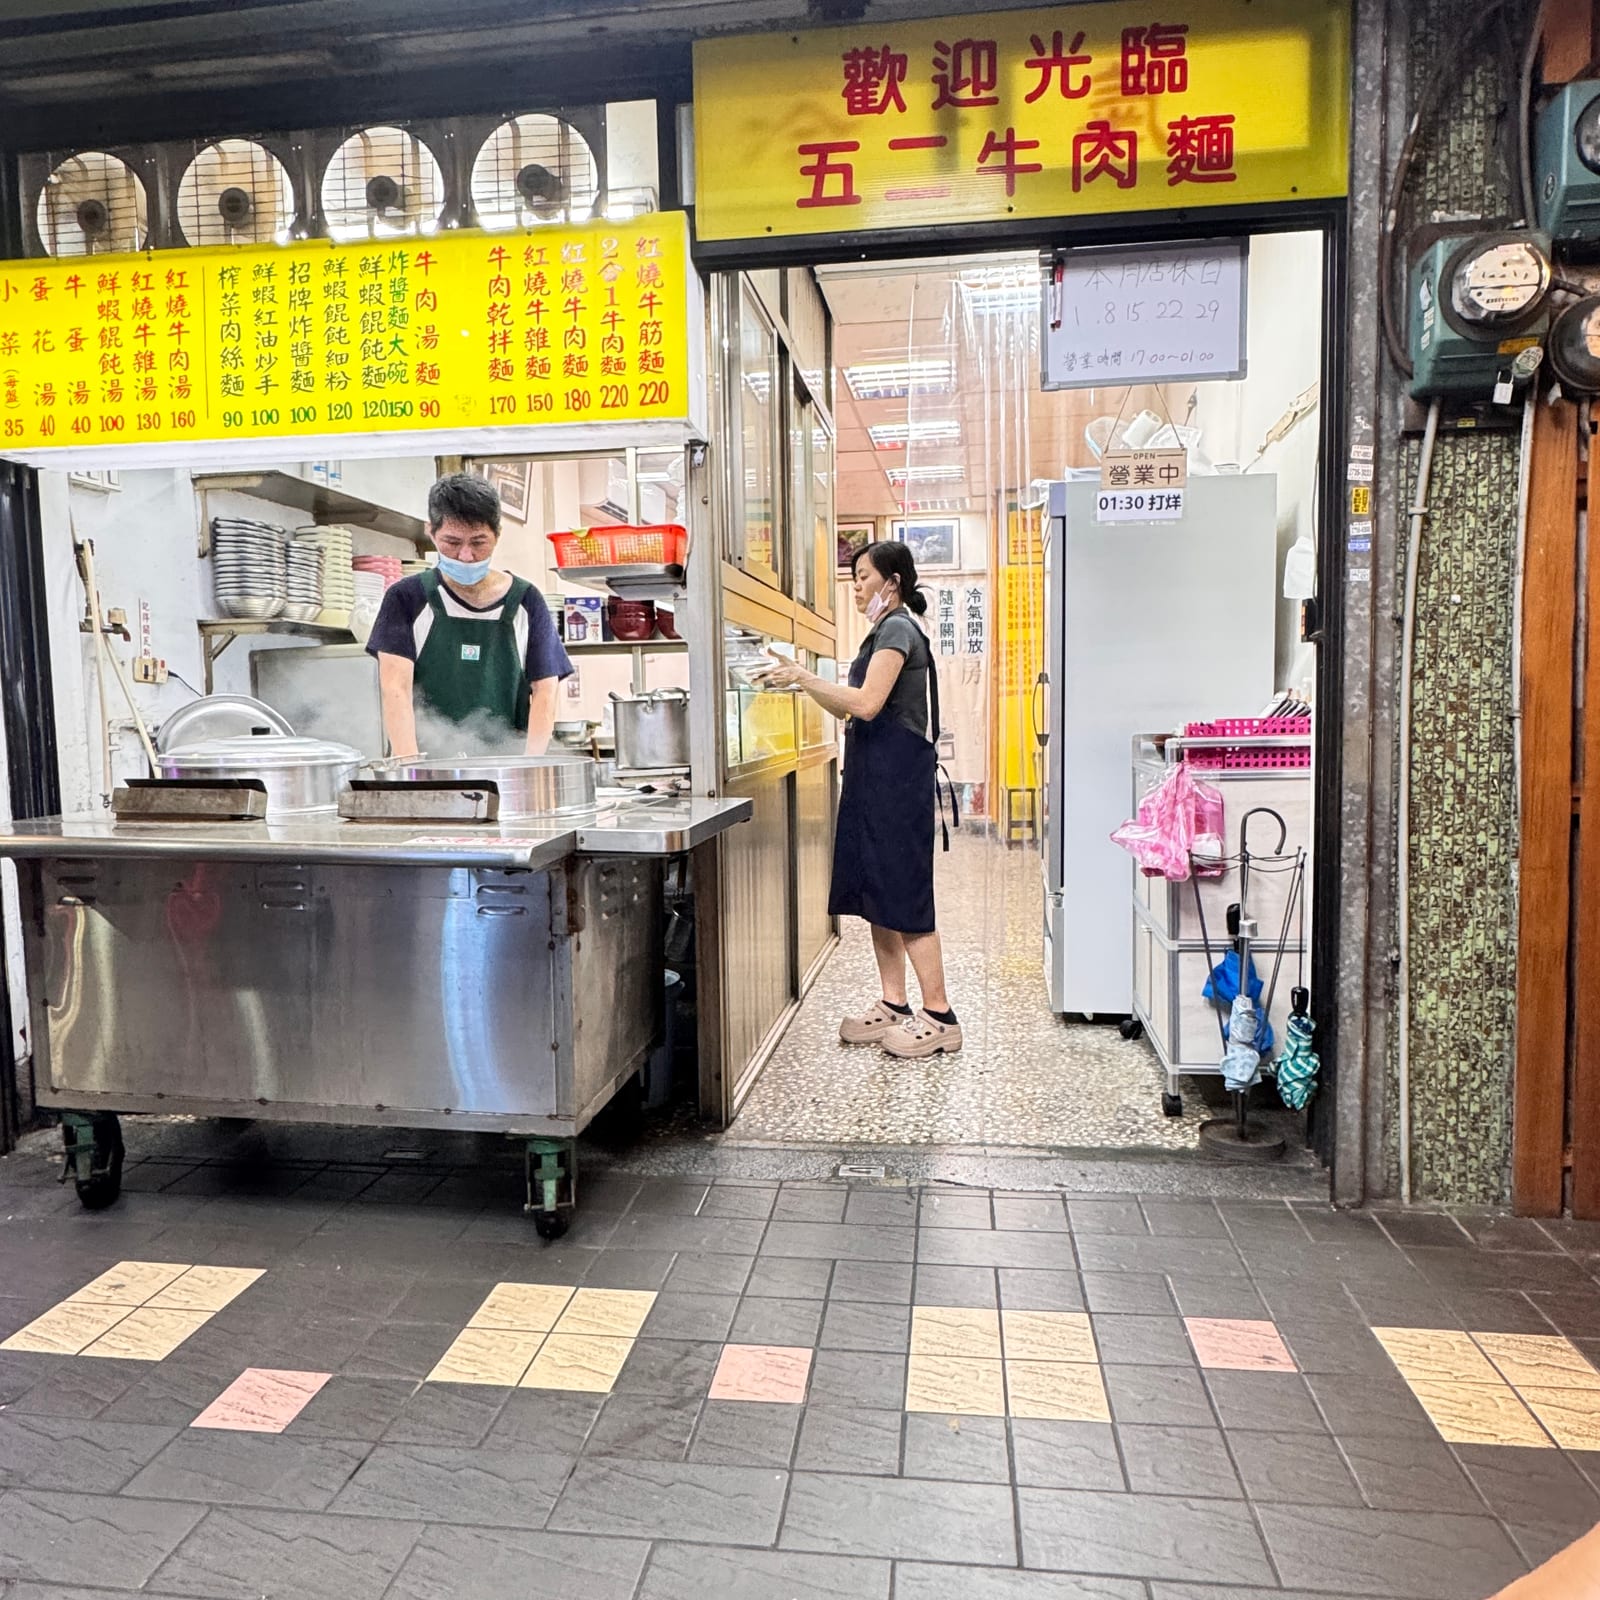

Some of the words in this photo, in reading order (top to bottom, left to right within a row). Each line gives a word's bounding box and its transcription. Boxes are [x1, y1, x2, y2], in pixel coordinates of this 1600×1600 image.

[842, 23, 1189, 116] 歡迎光臨
[796, 113, 1237, 208] 五二牛肉麵
[1084, 256, 1223, 291] 本月店休日
[0, 279, 21, 356] 小菜
[358, 253, 386, 389] 鮮蝦餛飩麵
[387, 250, 409, 386] 炸醬麵大碗
[413, 251, 440, 386] 牛肉湯麵
[486, 246, 514, 382] 牛肉乾拌麵
[523, 244, 551, 380] 紅燒牛雜麵
[560, 242, 589, 378] 紅燒牛肉麵
[597, 238, 626, 377] 2合1牛肉麵
[635, 236, 665, 375] 紅燒牛筋麵
[1156, 300, 1184, 319] 22
[1195, 299, 1220, 322] 29
[30, 277, 57, 406] 蛋花湯
[64, 274, 90, 406] 牛蛋湯
[97, 272, 124, 404] 鮮蝦餛飩湯
[131, 271, 158, 402] 紅燒牛雜湯
[165, 269, 192, 400] 紅燒牛肉湯
[218, 266, 244, 398] 榨菜肉絲麵
[252, 263, 279, 396] 鮮蝦紅油炒手
[288, 261, 314, 394] 招牌炸醬麵
[323, 257, 351, 391] 鮮蝦餛飩細粉
[1063, 349, 1122, 372] 營業時間
[363, 400, 388, 419] 120
[388, 401, 413, 417] 150
[420, 399, 440, 418] 90
[490, 395, 516, 415] 170
[527, 392, 553, 412] 150
[564, 389, 590, 411] 180
[600, 384, 628, 409] 220
[639, 381, 669, 406] 220
[5, 419, 24, 436] 35
[40, 415, 55, 436] 40
[71, 415, 91, 433] 40
[100, 415, 124, 432] 100
[137, 412, 161, 430] 130
[171, 410, 195, 428] 160
[223, 411, 243, 427] 90
[252, 409, 279, 425] 100
[291, 407, 316, 423] 100
[327, 402, 352, 421] 120
[1109, 463, 1179, 486] 營業中
[1099, 496, 1144, 511] 01:30
[1148, 494, 1182, 511] 打烊
[939, 590, 955, 655] 隨手關門
[967, 588, 983, 654] 冷氣開放
